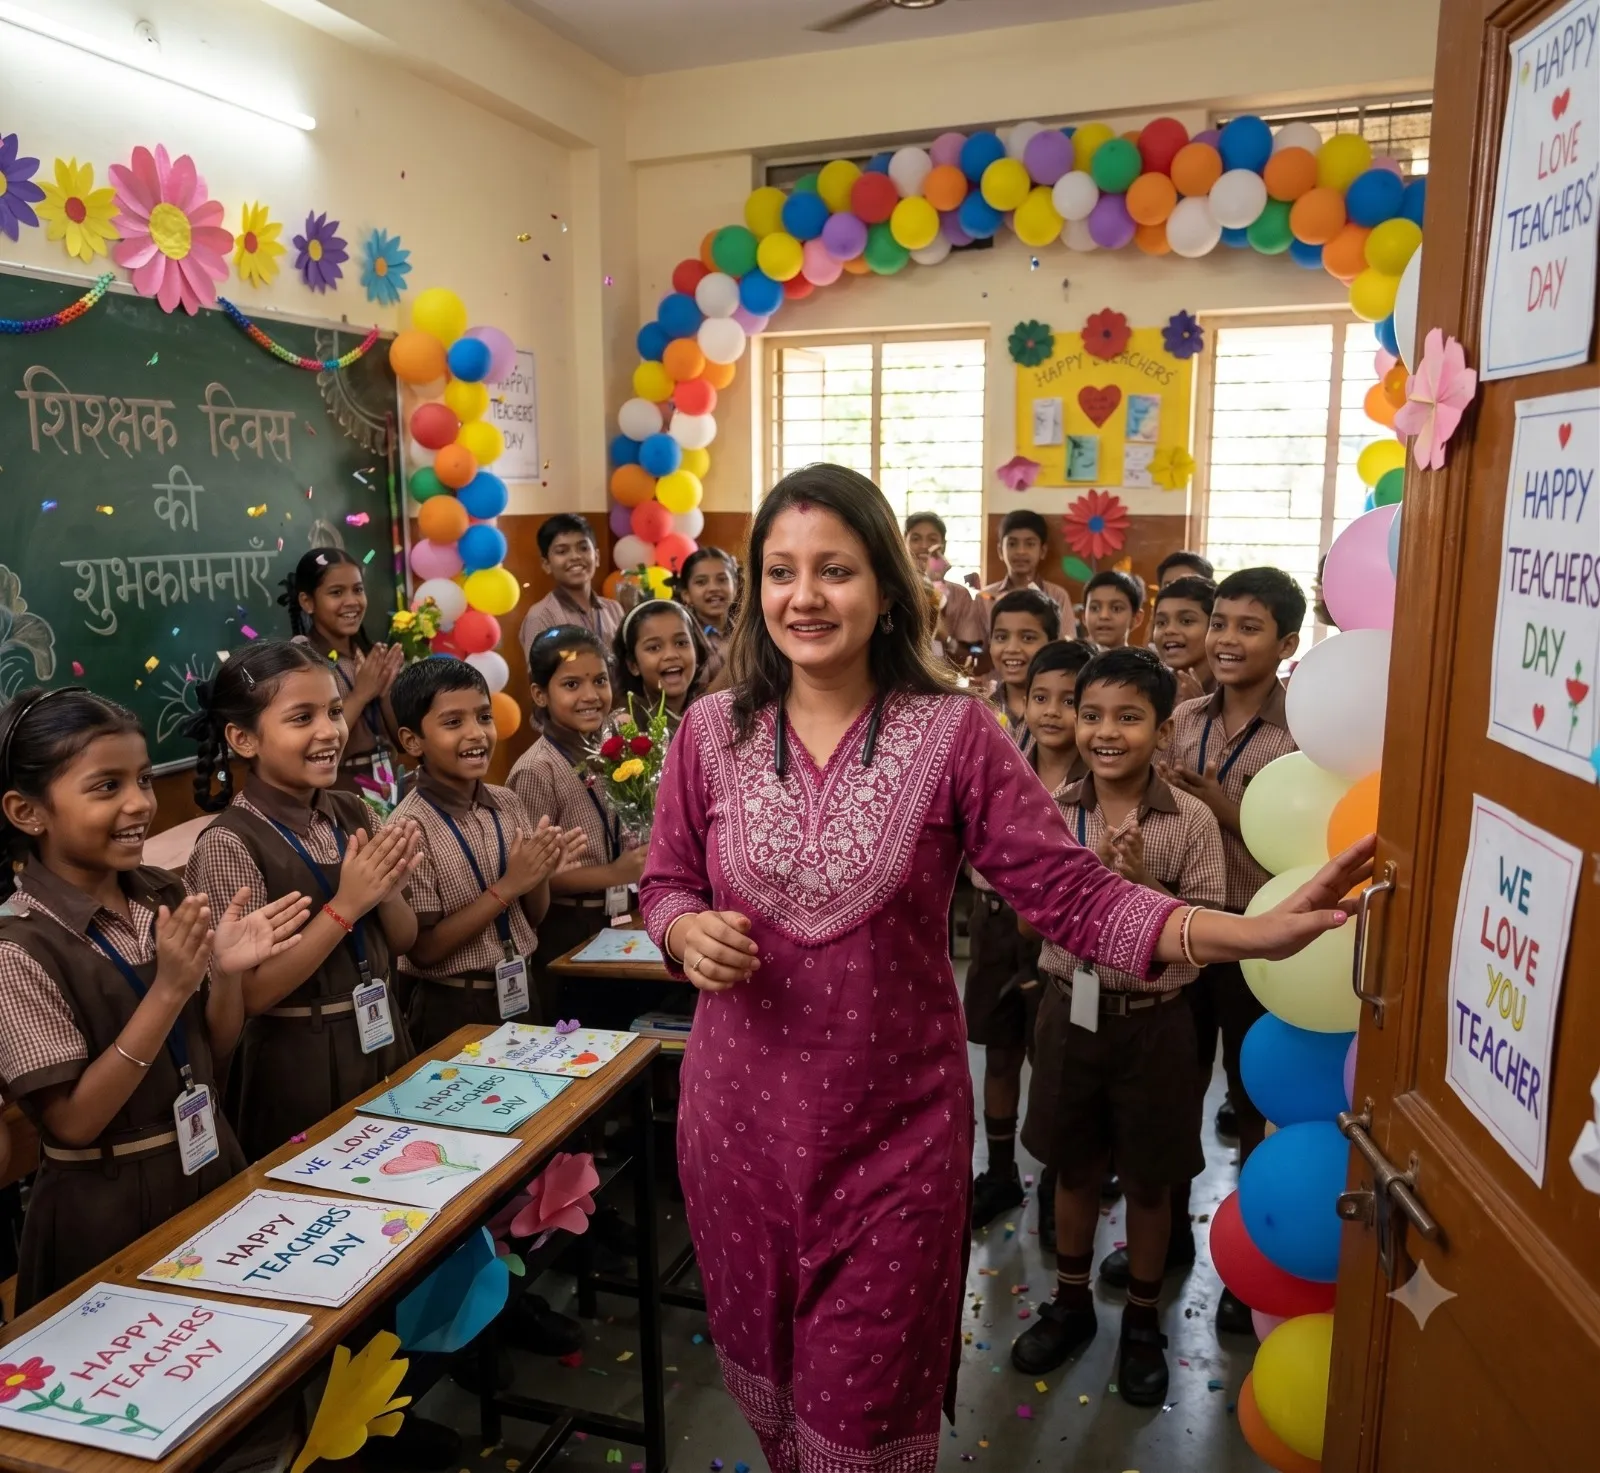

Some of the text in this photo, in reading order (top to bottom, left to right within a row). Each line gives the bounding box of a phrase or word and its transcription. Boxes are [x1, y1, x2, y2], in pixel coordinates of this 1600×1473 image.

[1533, 5, 1600, 93] HAPPY
[1537, 121, 1582, 180] LOVE
[1527, 257, 1568, 313] DAY
[1034, 352, 1083, 388] HAPPY
[198, 382, 296, 462] दिवस
[504, 430, 524, 450] DAY
[152, 464, 204, 531] की
[1523, 467, 1594, 523] HAPPY
[1521, 621, 1566, 677] DAY
[1499, 855, 1533, 915] WE
[1480, 906, 1540, 986] LOVE
[1485, 963, 1527, 1032] YOU
[1456, 999, 1541, 1120] TEACHER
[415, 1077, 474, 1110] HAPPY
[492, 1095, 528, 1115] DAY
[295, 1123, 384, 1176] WE LOVE
[216, 1213, 296, 1266] HAPPY
[242, 1206, 352, 1282] TEACHERS
[312, 1232, 366, 1267] DAY
[70, 1312, 164, 1381] HAPPY
[163, 1338, 223, 1382] DAY
